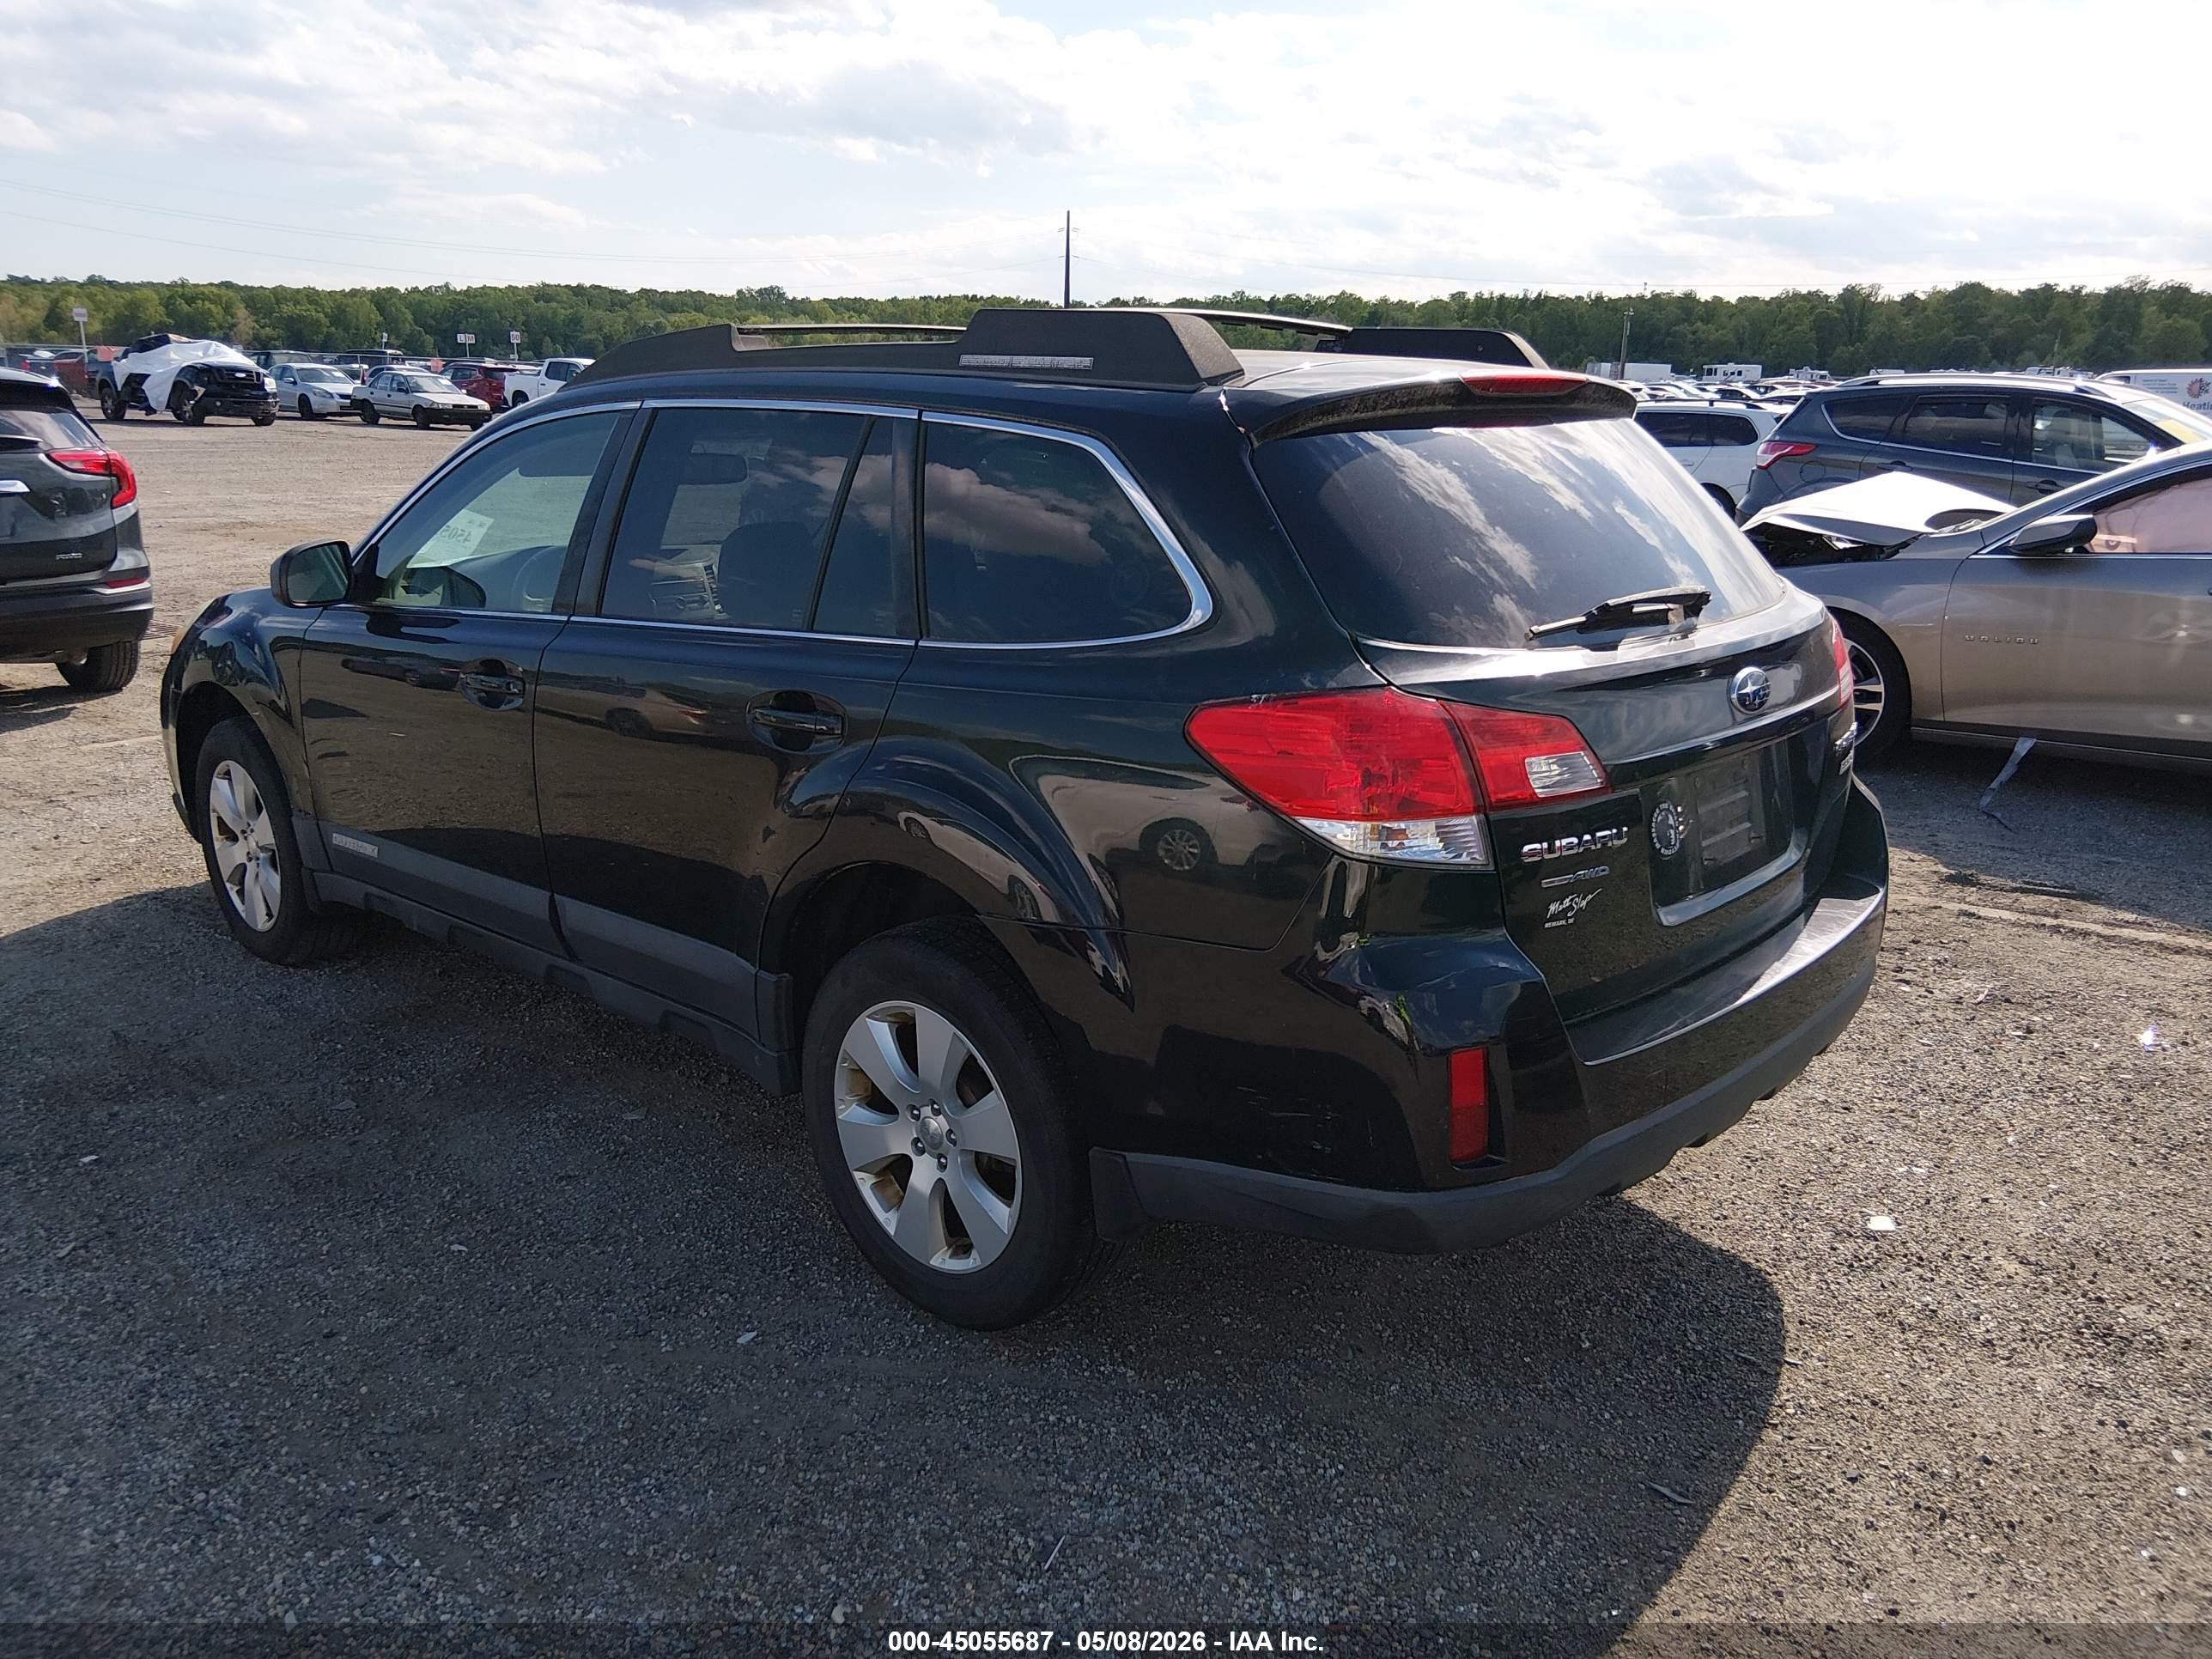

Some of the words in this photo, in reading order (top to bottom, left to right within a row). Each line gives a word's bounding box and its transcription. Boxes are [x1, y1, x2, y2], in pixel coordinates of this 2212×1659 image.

[2183, 401, 2212, 410] Heati
[1964, 635, 2039, 645] MALIBU
[1521, 826, 1628, 863] SUBARU
